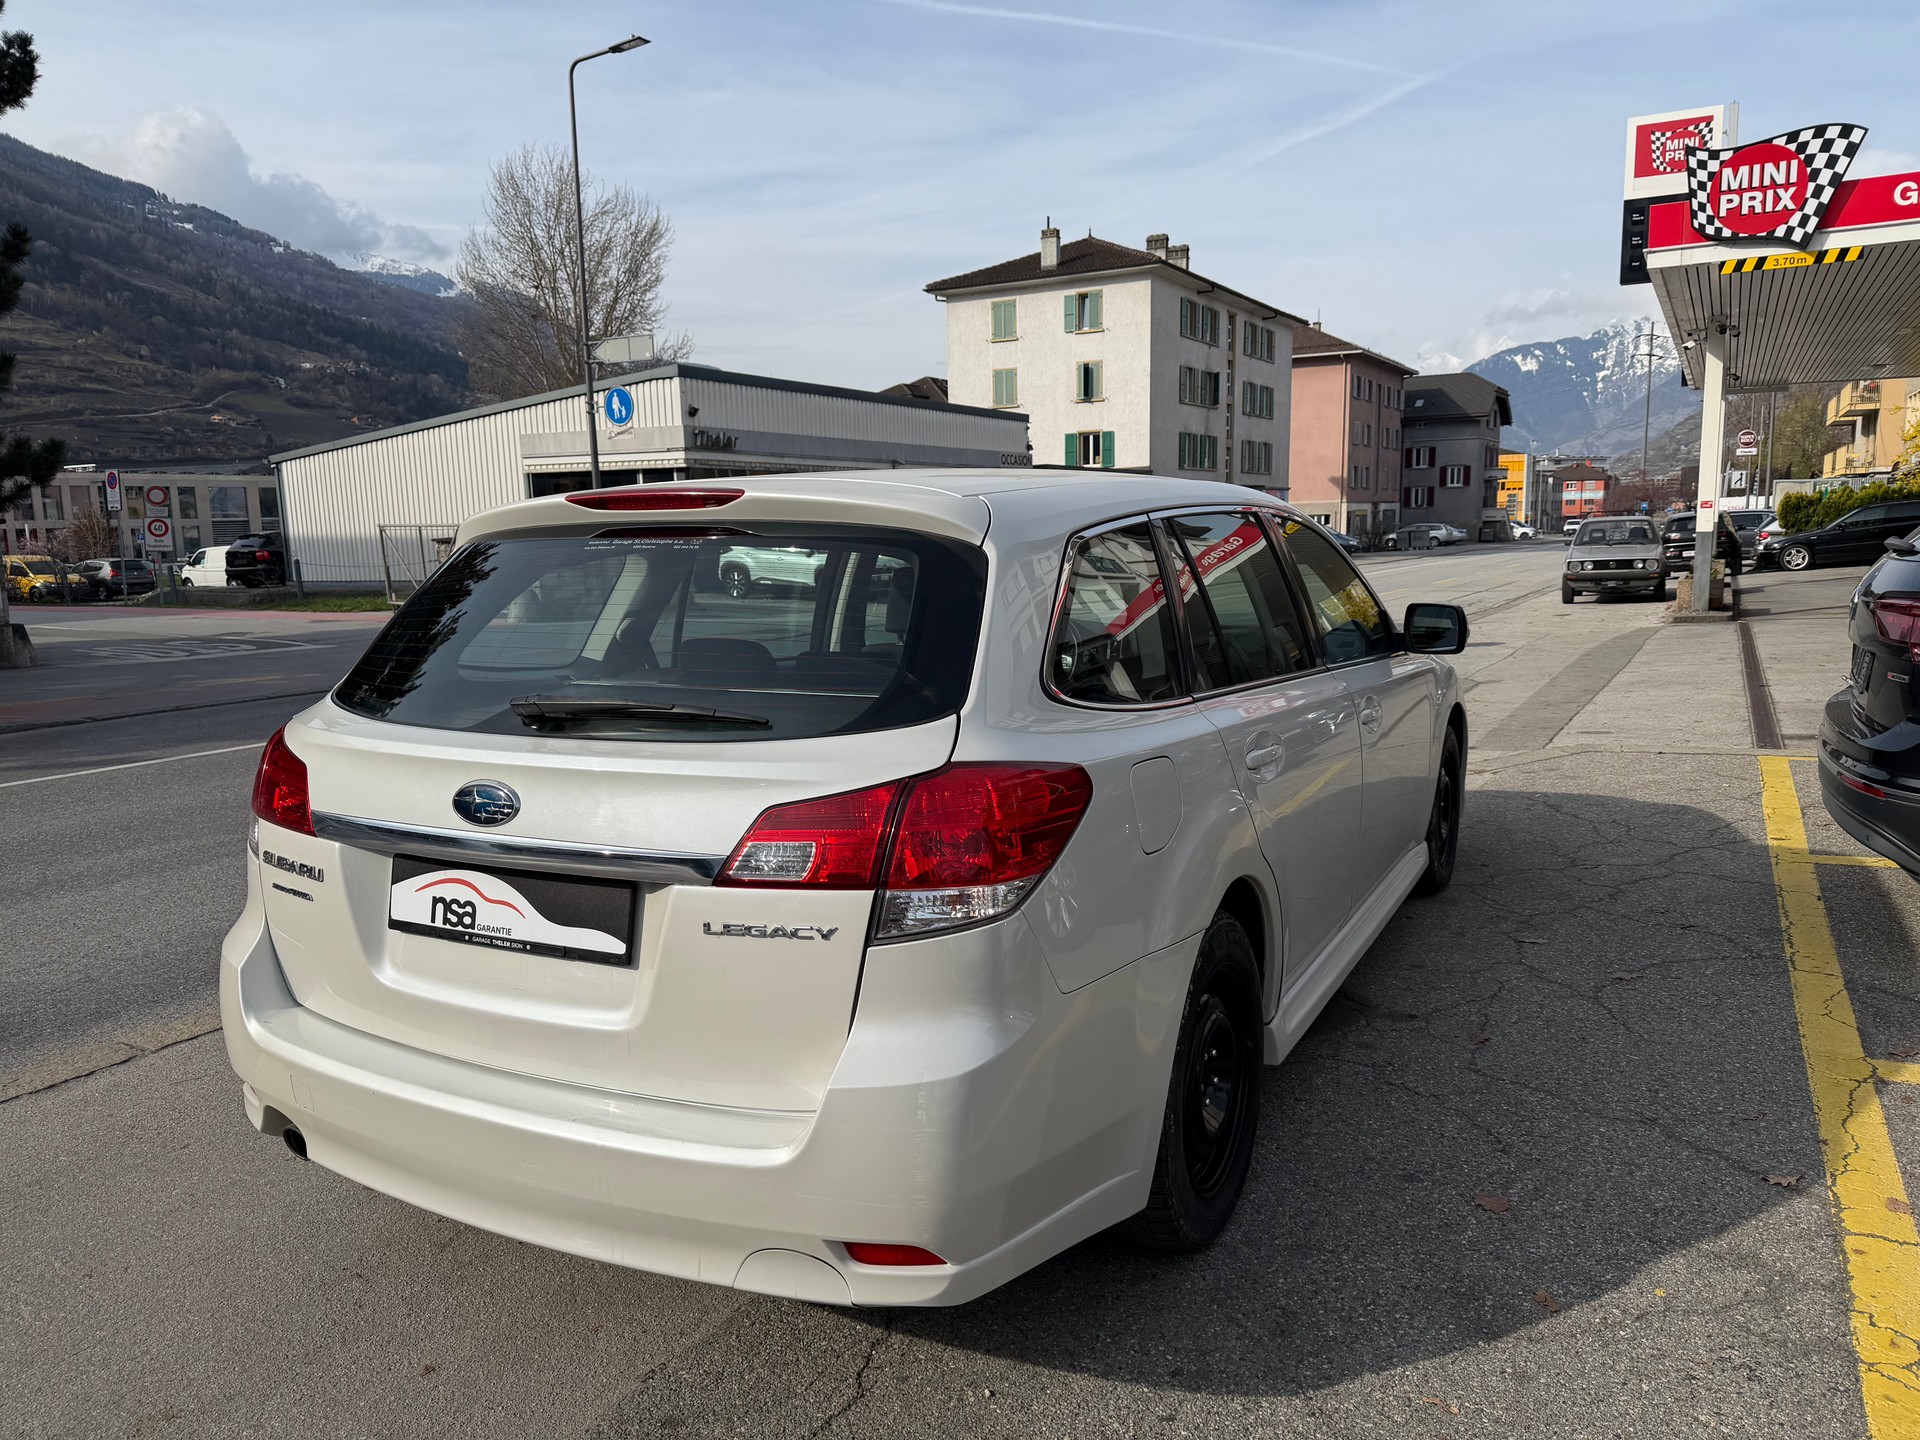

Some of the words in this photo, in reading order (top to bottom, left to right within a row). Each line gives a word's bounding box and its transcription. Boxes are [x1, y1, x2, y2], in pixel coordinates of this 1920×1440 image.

[1665, 136, 1700, 151] MINI
[1665, 150, 1687, 163] PR
[1719, 159, 1799, 192] MINI
[1718, 186, 1798, 219] PRIX
[1773, 256, 1796, 267] 3.70
[1796, 257, 1807, 265] m
[153, 524, 163, 532] 40
[262, 850, 325, 883] SUBARU
[430, 895, 477, 930] nsa
[476, 923, 513, 937] GARANTIE
[472, 936, 491, 944] GARAGE
[702, 921, 840, 942] LEGACY
